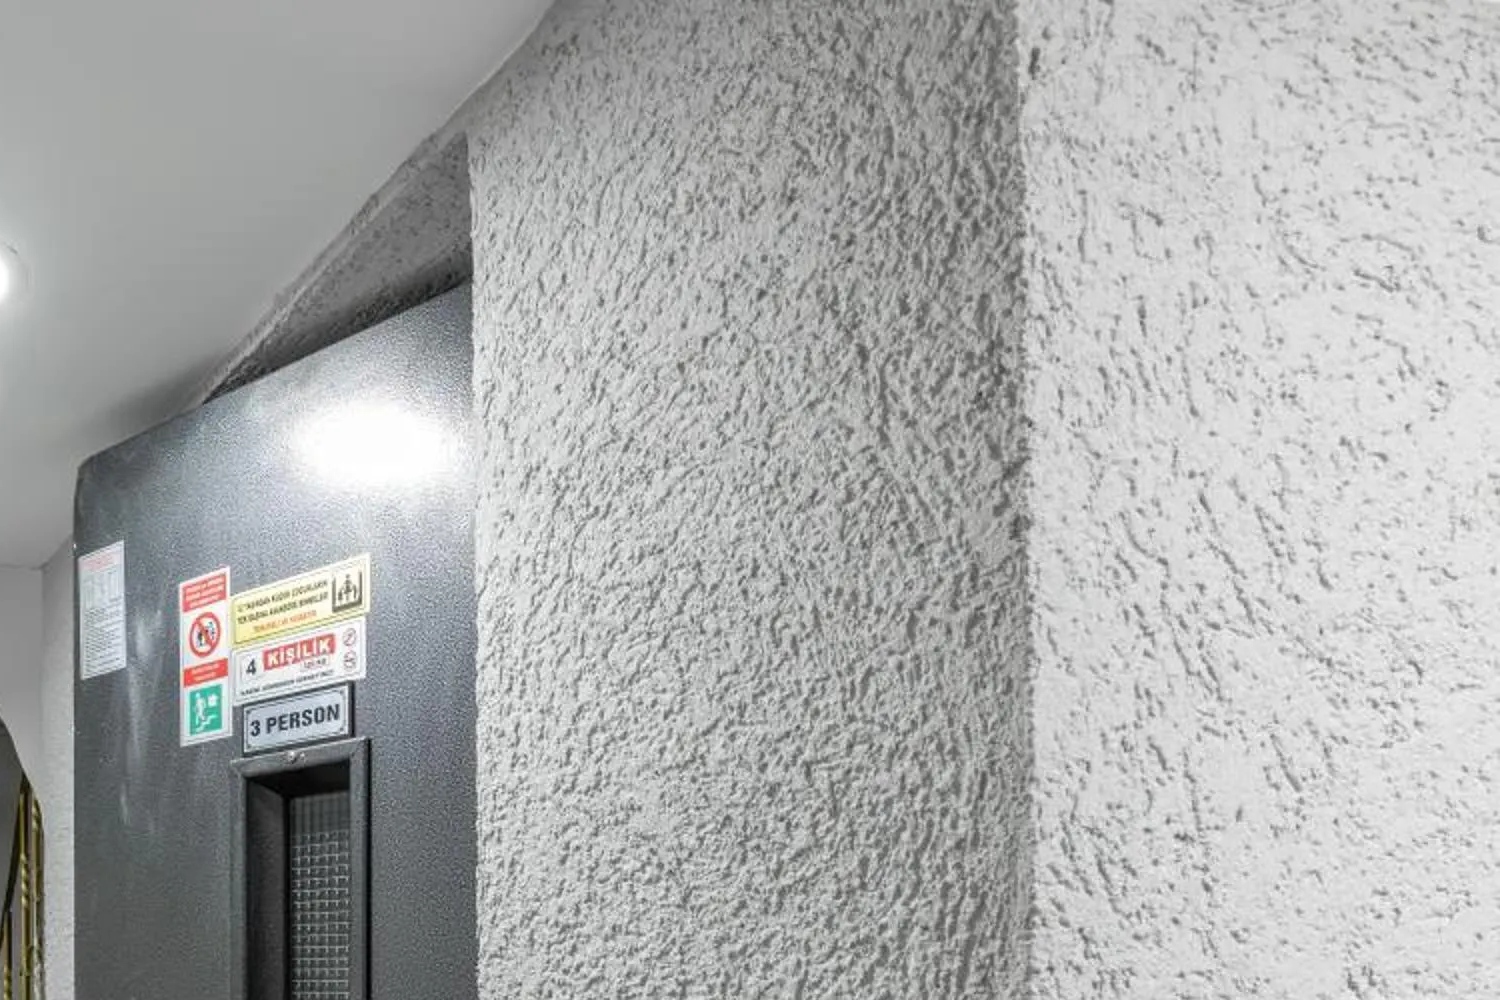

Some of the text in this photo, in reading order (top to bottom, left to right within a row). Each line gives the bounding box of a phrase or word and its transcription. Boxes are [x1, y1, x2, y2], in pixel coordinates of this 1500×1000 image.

[246, 658, 257, 675] 4
[250, 703, 340, 737] 3 PERSON
